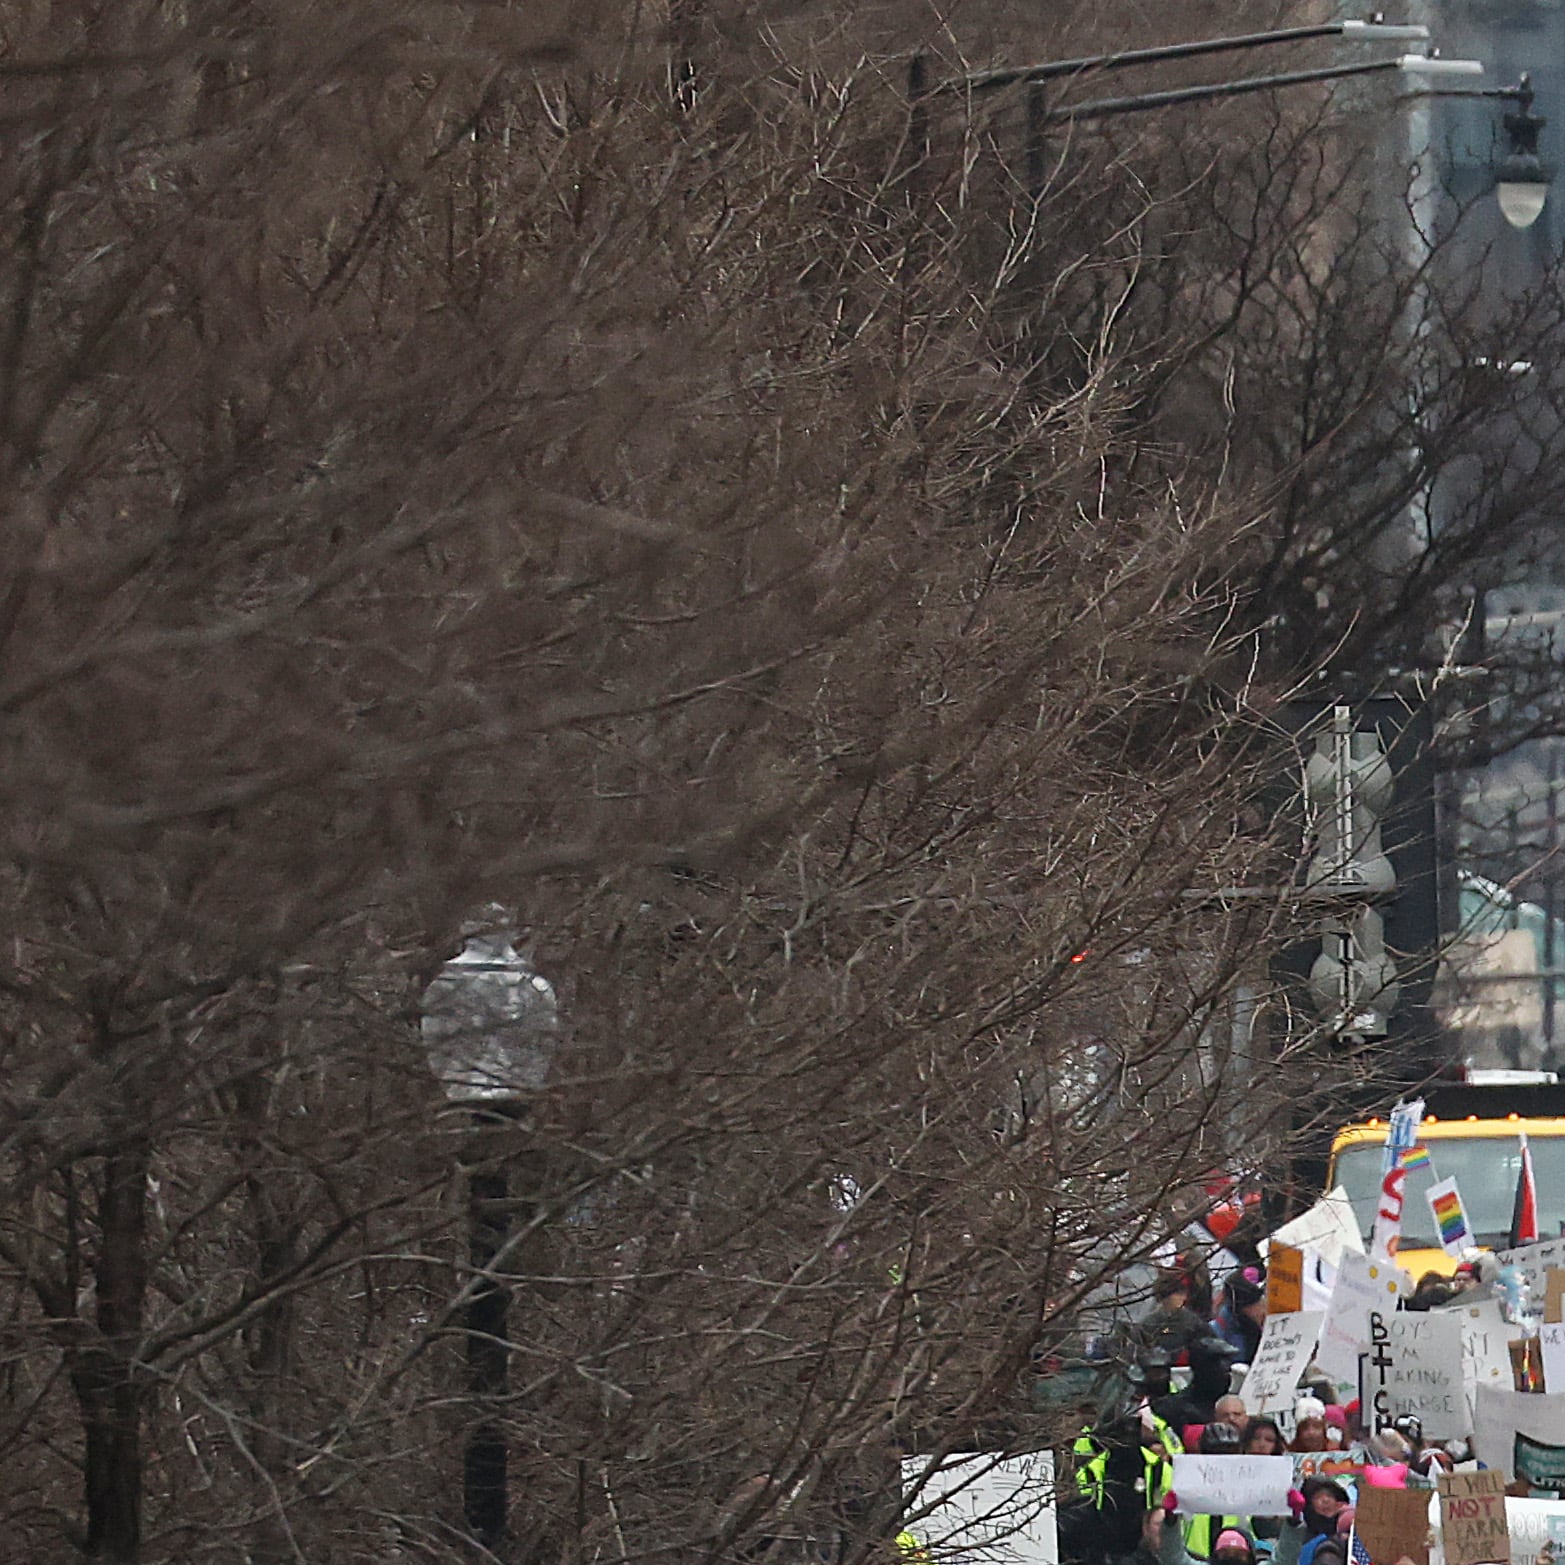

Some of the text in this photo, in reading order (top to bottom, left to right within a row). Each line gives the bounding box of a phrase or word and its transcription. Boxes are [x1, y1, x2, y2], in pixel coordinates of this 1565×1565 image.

[1269, 1318, 1289, 1336] IT
[1463, 1475, 1499, 1494] WILL
[1449, 1496, 1496, 1521] NOT
